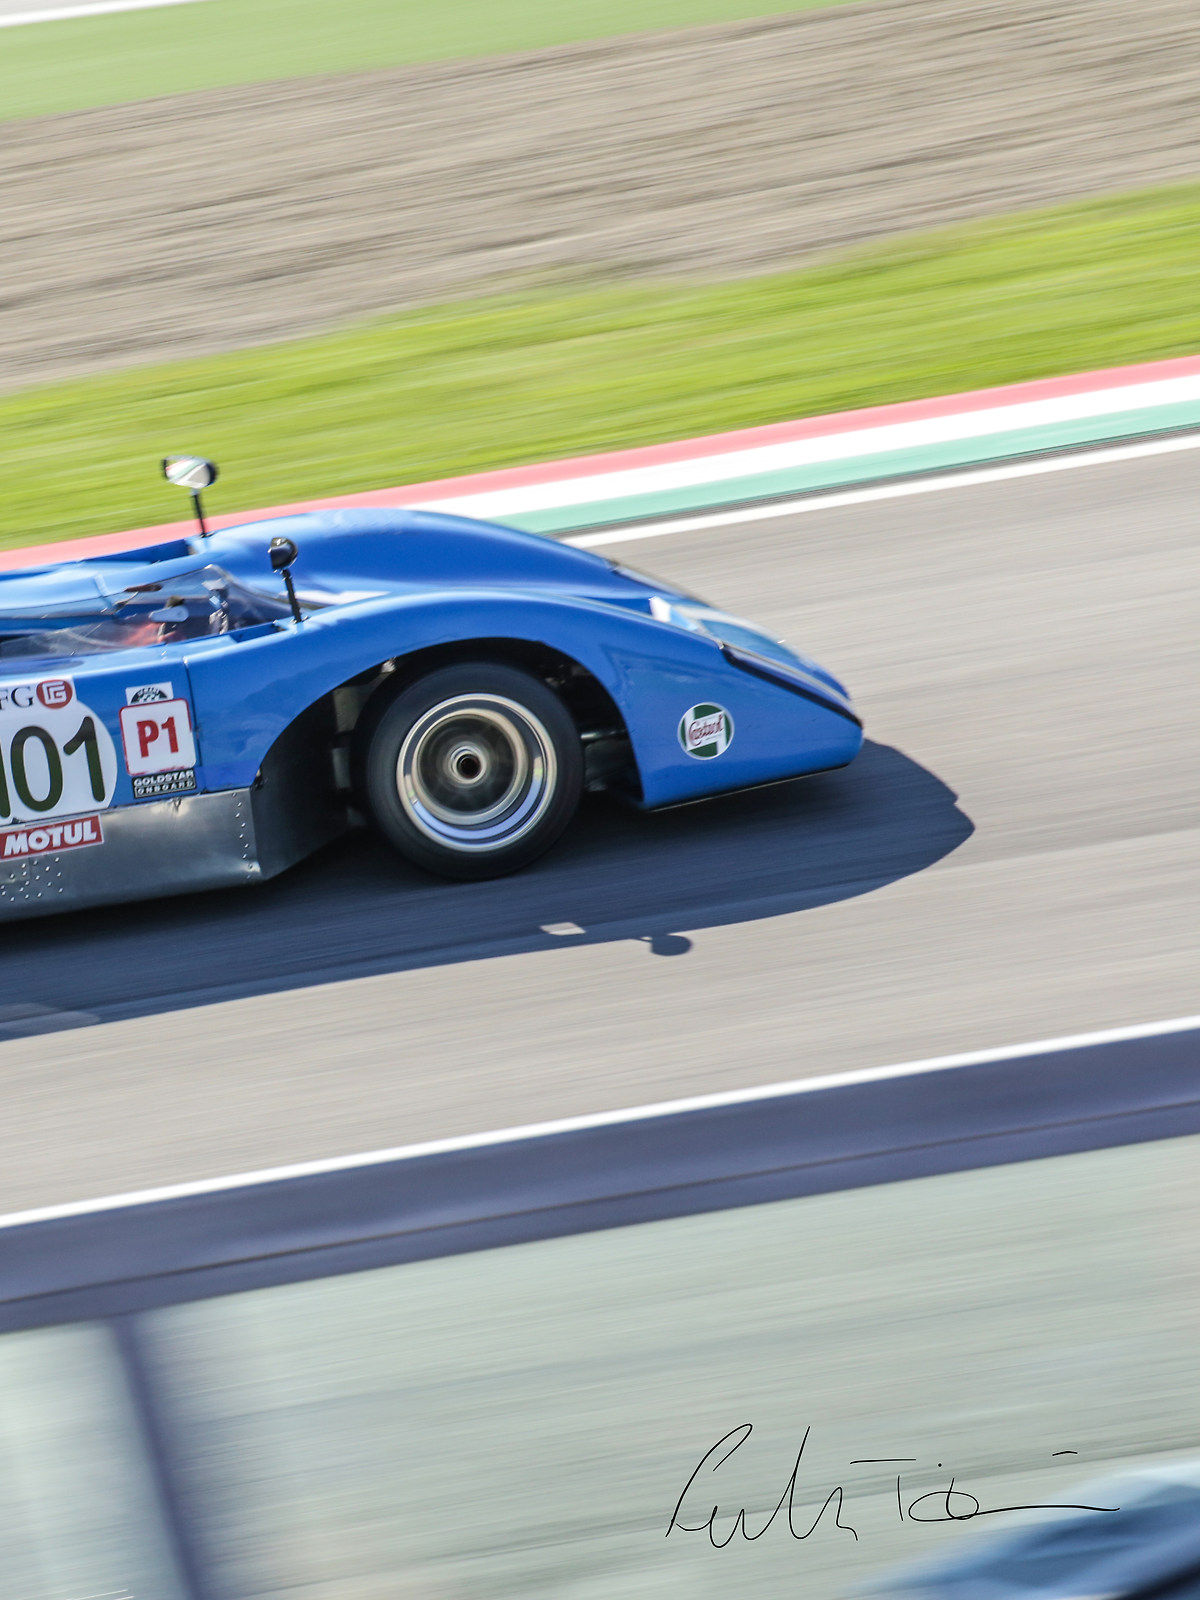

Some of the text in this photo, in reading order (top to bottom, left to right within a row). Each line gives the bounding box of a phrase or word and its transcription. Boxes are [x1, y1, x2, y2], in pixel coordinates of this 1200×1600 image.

[136, 716, 179, 758] P1
[134, 770, 194, 787] GOLDSTAR
[138, 781, 193, 795] ONBOARD
[3, 820, 97, 857] MOTUL
